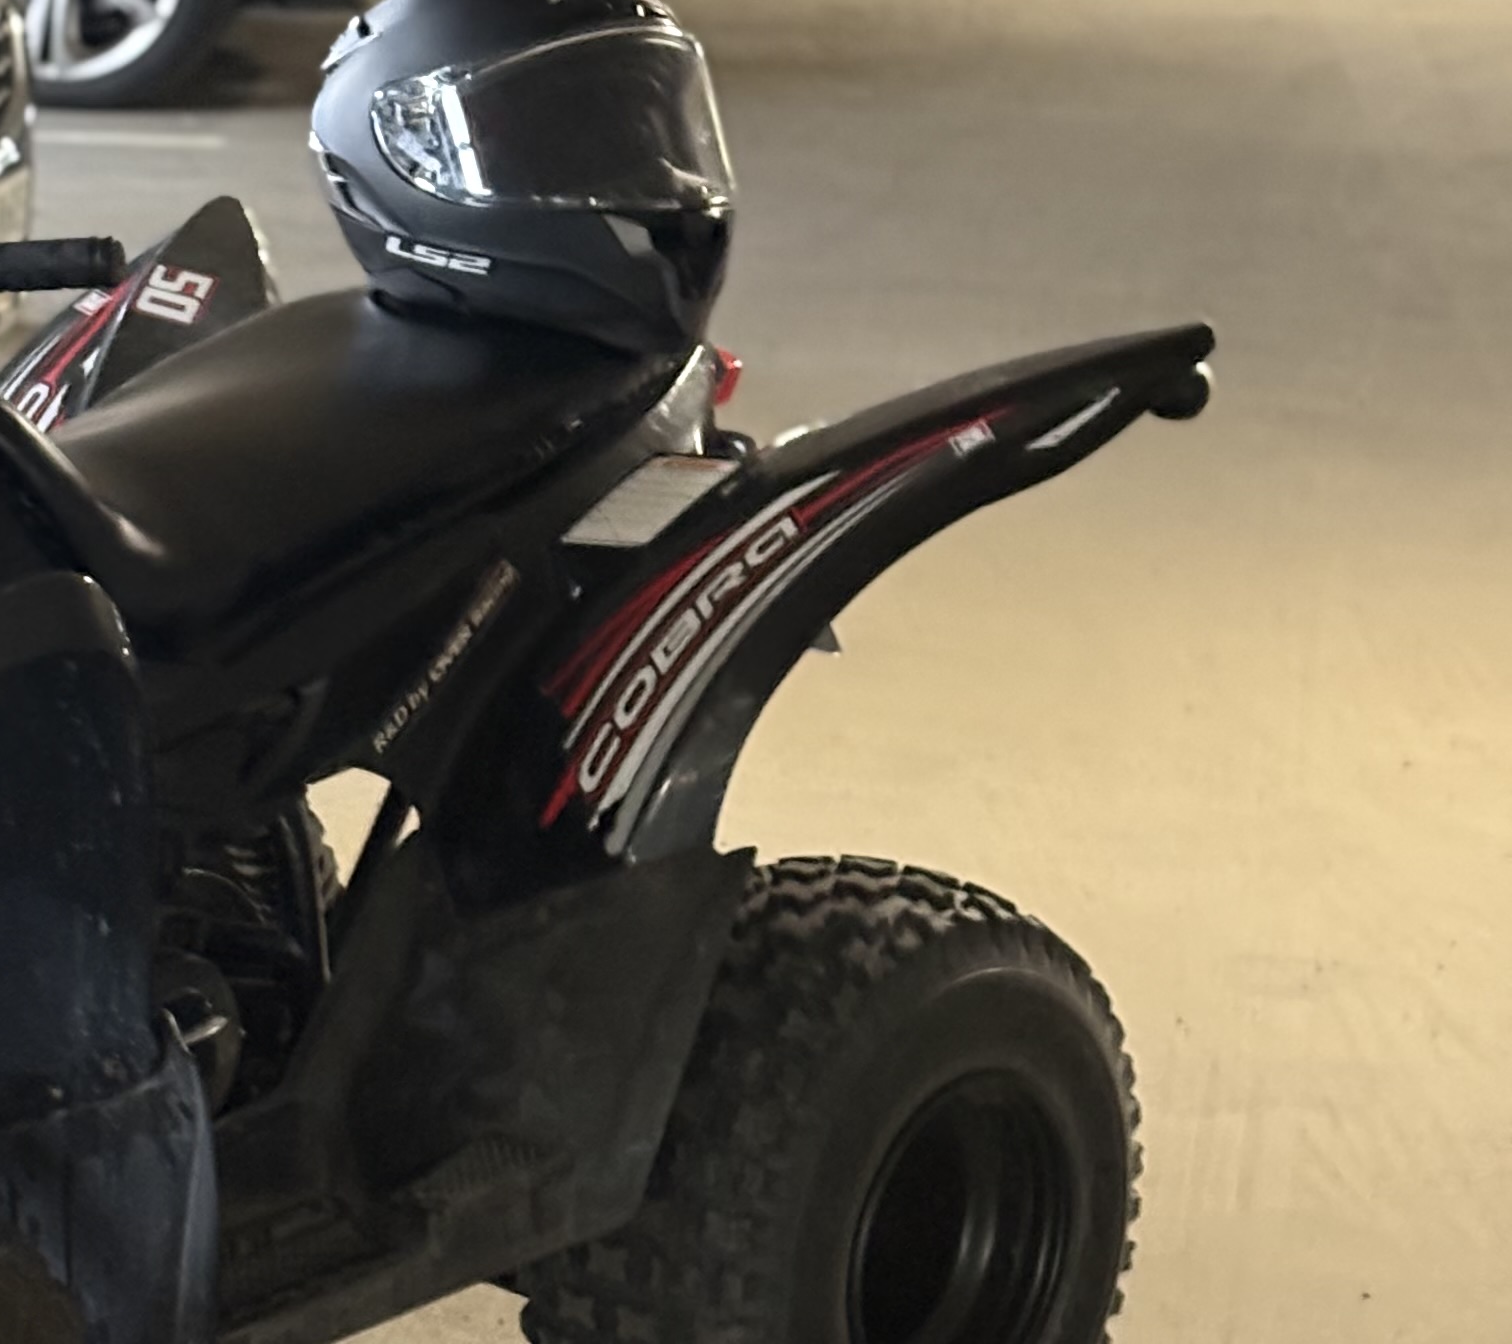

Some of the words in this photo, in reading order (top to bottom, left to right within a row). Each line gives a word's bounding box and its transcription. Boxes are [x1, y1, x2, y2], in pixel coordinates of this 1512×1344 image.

[385, 235, 492, 276] LS2
[135, 263, 215, 326] 50
[577, 515, 800, 793] COBRA
